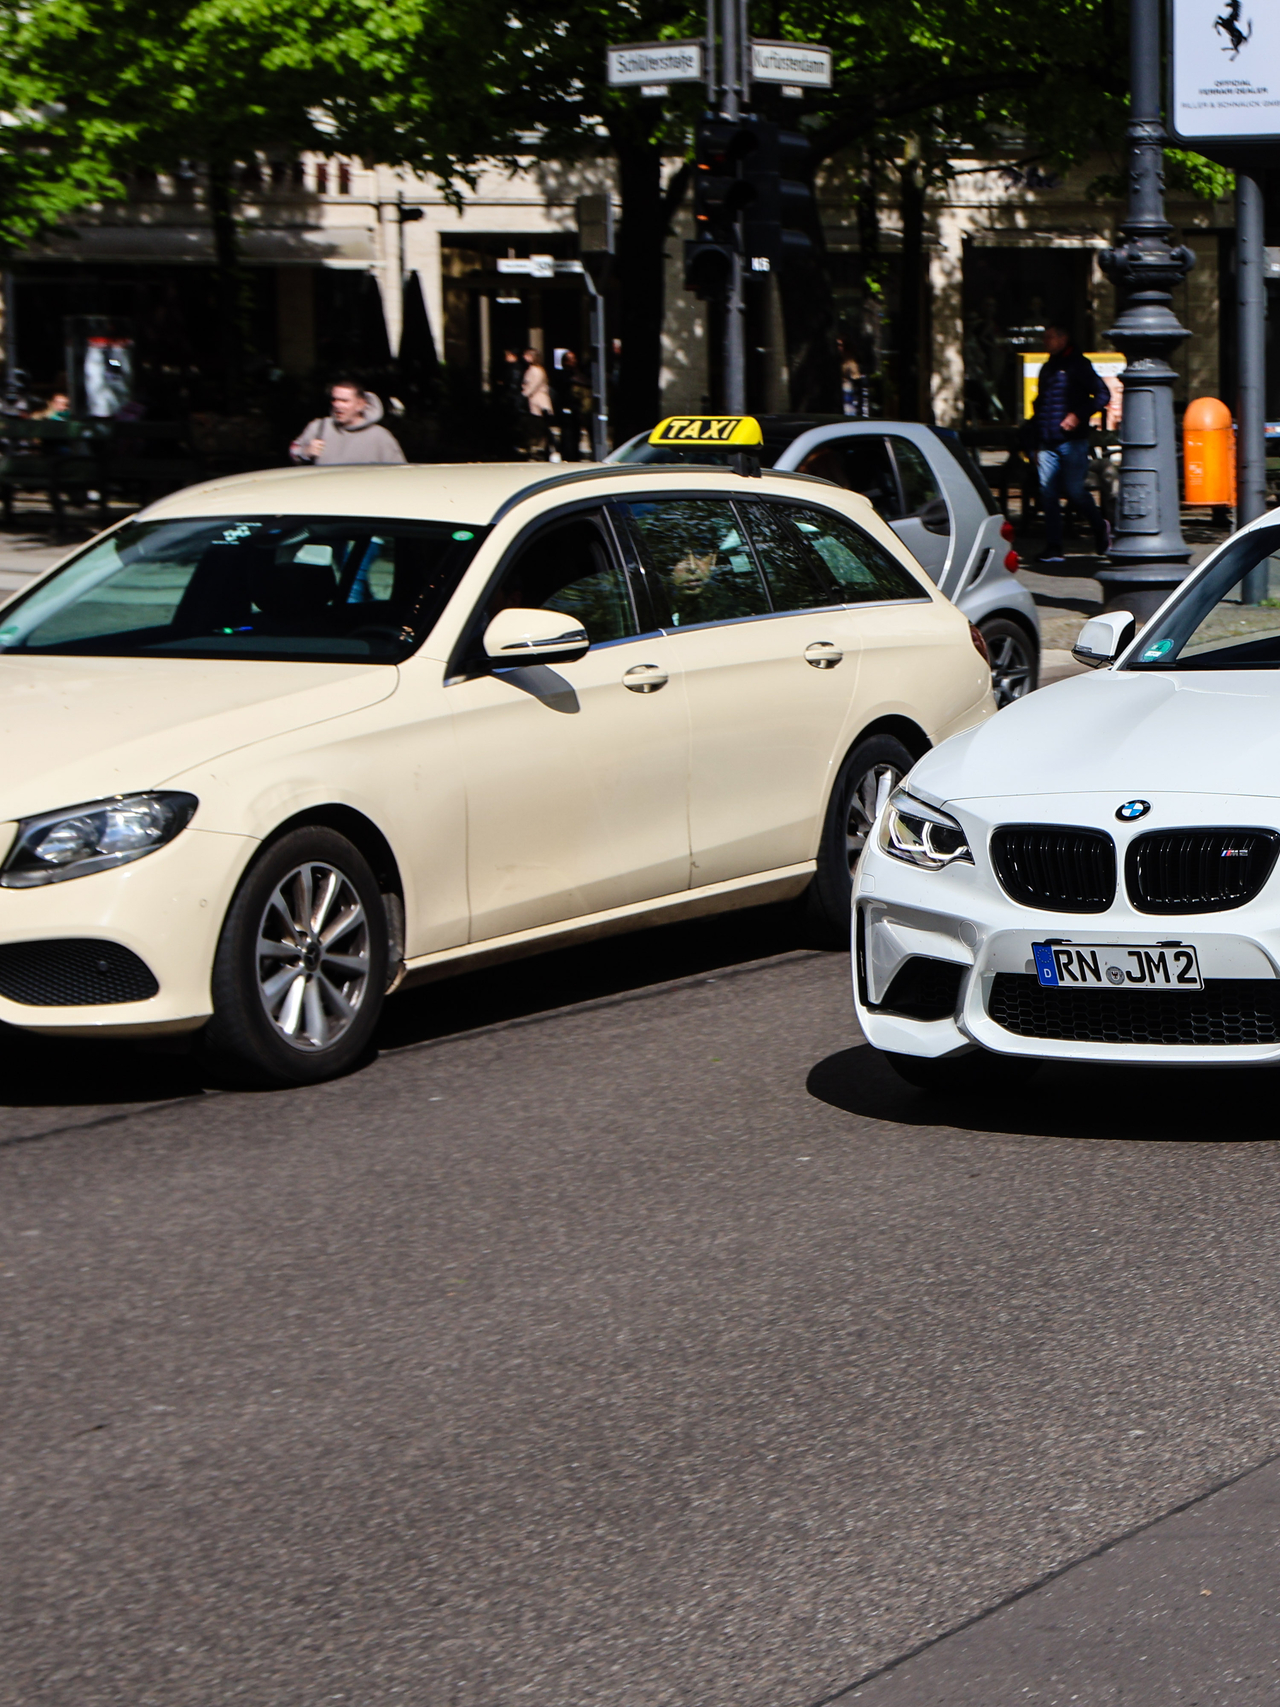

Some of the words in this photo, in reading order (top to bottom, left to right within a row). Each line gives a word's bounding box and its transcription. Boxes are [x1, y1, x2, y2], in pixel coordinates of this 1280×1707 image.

[1235, 87, 1268, 95] DEALER
[667, 420, 738, 439] TAXI
[1044, 968, 1052, 978] D
[1054, 950, 1102, 982] RN
[1125, 951, 1171, 983] JM
[1174, 951, 1198, 983] 2
